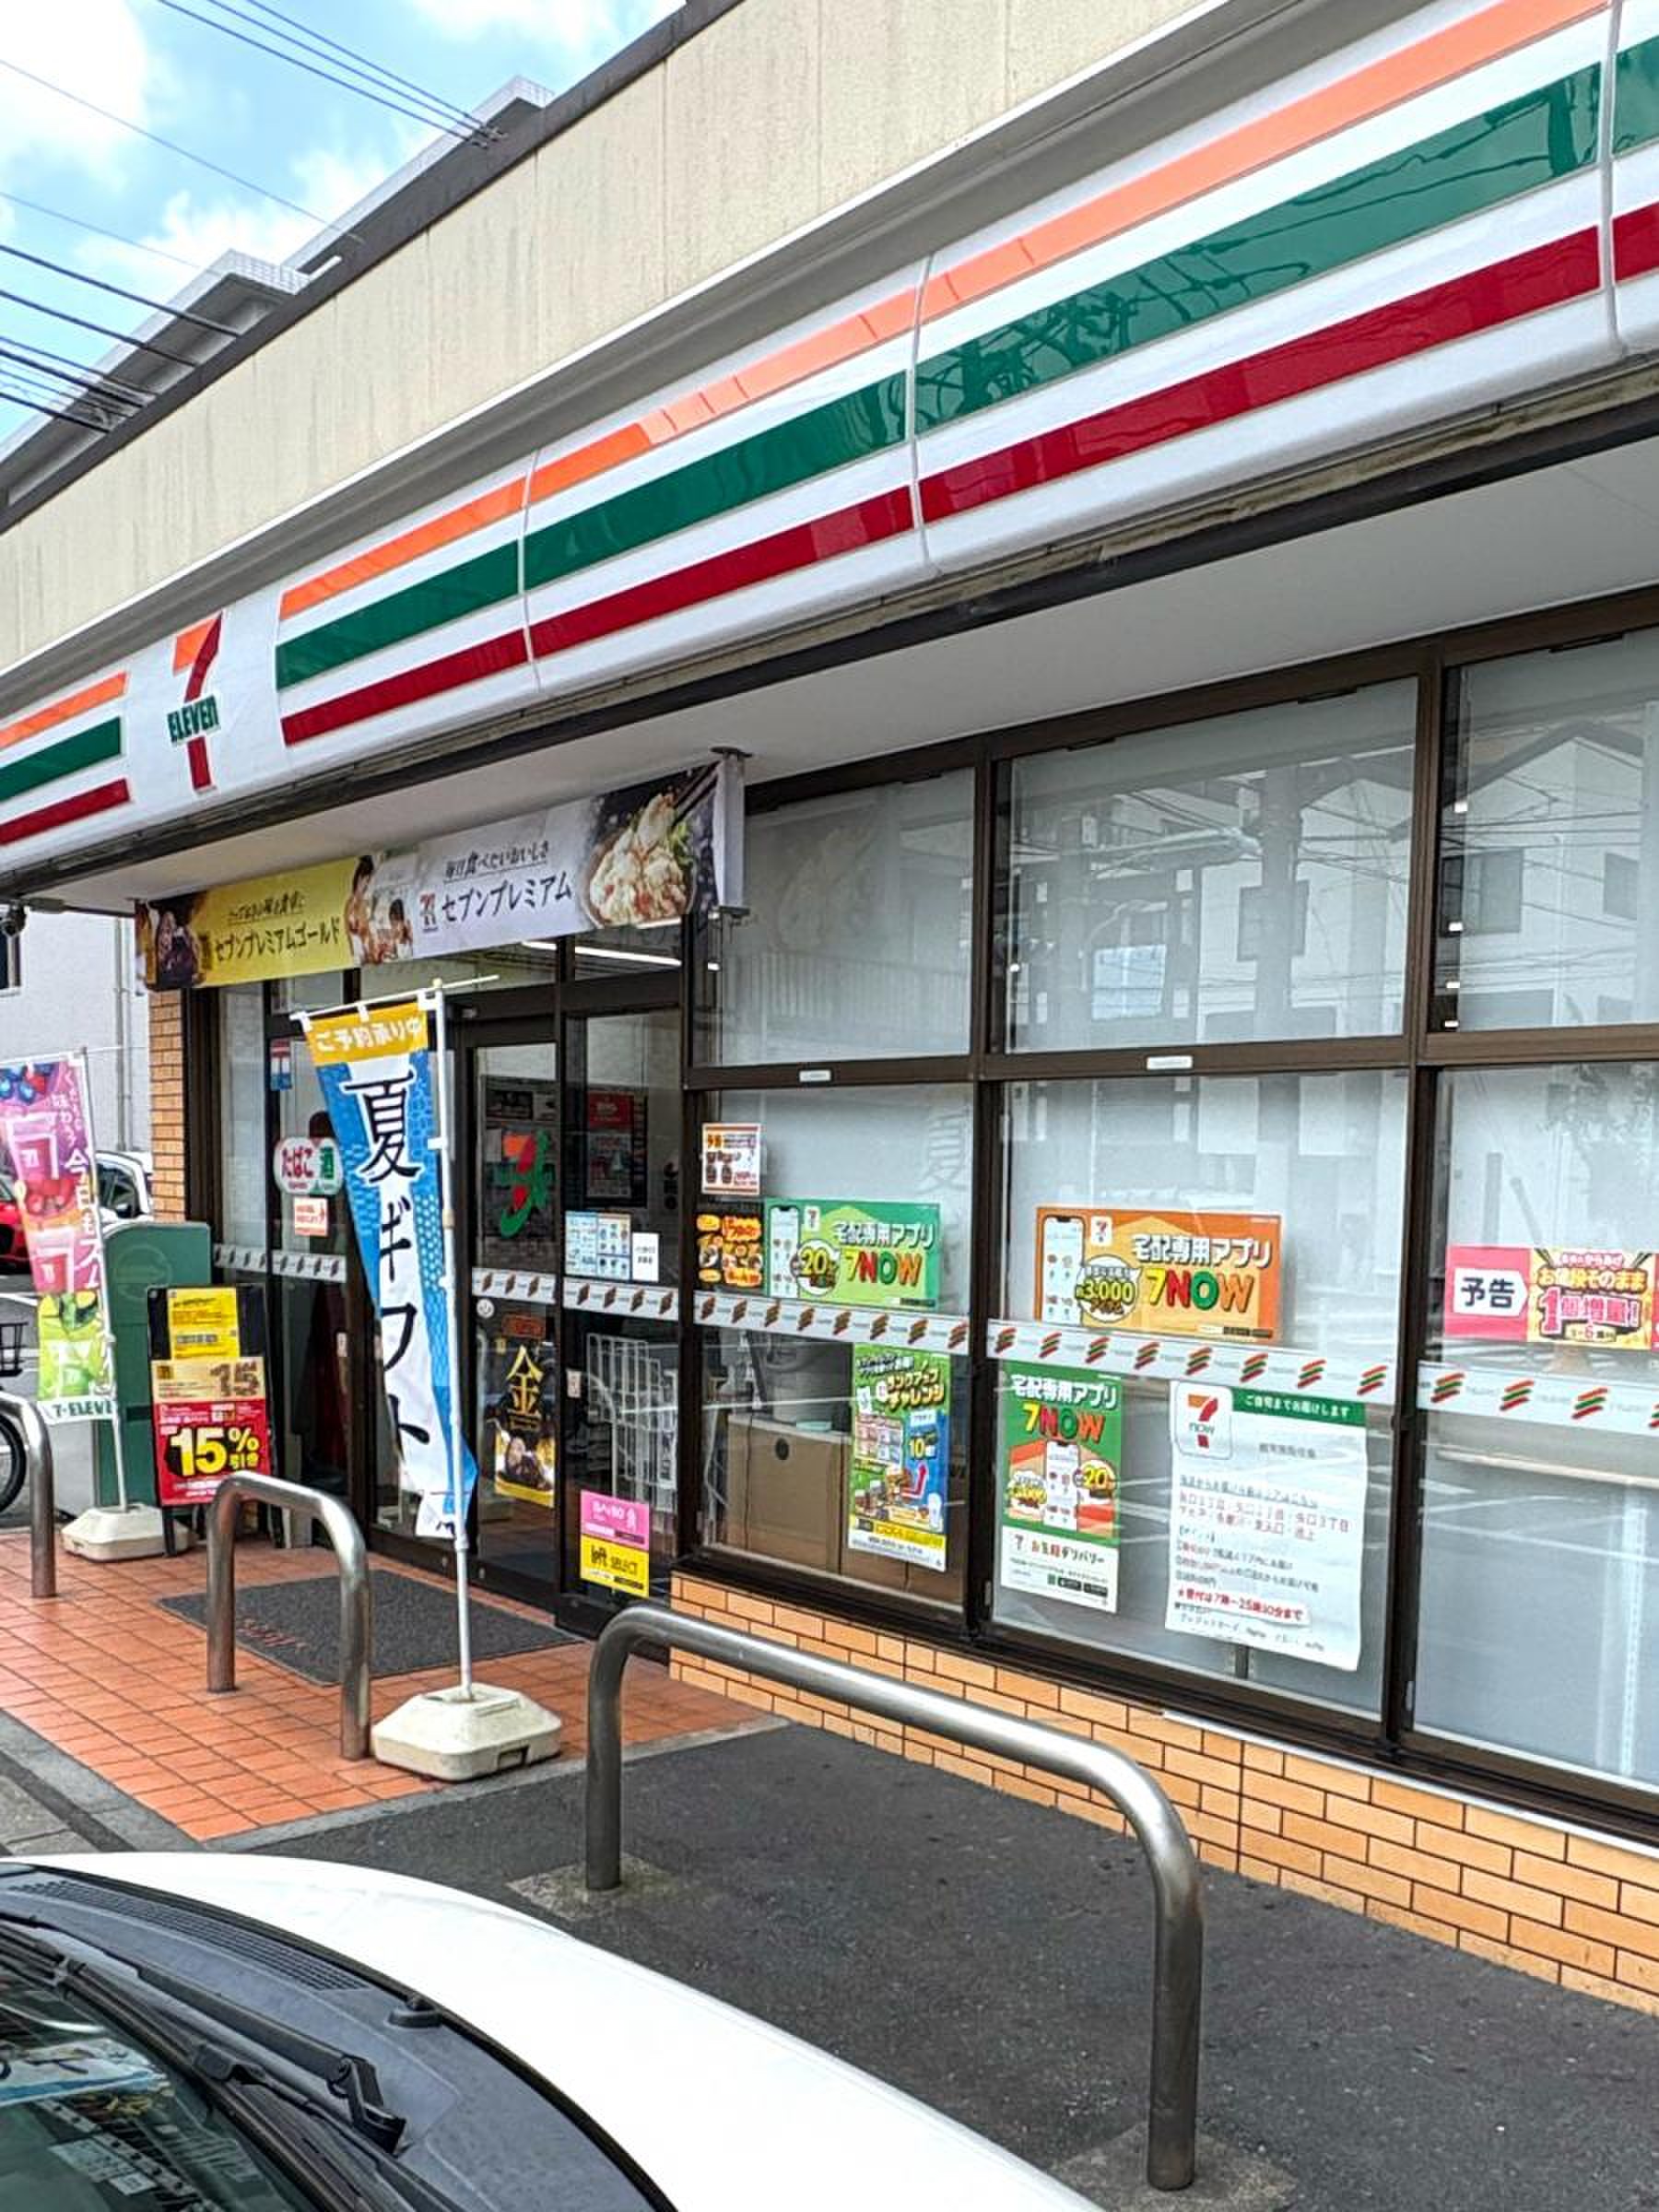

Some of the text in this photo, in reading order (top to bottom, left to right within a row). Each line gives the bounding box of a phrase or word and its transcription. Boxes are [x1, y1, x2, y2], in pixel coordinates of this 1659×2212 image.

[442, 871, 572, 923] セブンプレミアム
[216, 916, 340, 962] セブンプレミアムゴールド
[282, 1146, 314, 1179] たばこ
[340, 1069, 430, 1445] 夏ギフト
[843, 1248, 923, 1287] 7NOW
[1132, 1233, 1271, 1269] 宅配専用アプリ
[1143, 1268, 1253, 1314] 7NOW
[1461, 1277, 1515, 1309] 予告
[506, 1345, 545, 1418] 金
[1010, 1373, 1118, 1410] 宅配専用アプリ
[1022, 1401, 1105, 1443] 7NOW
